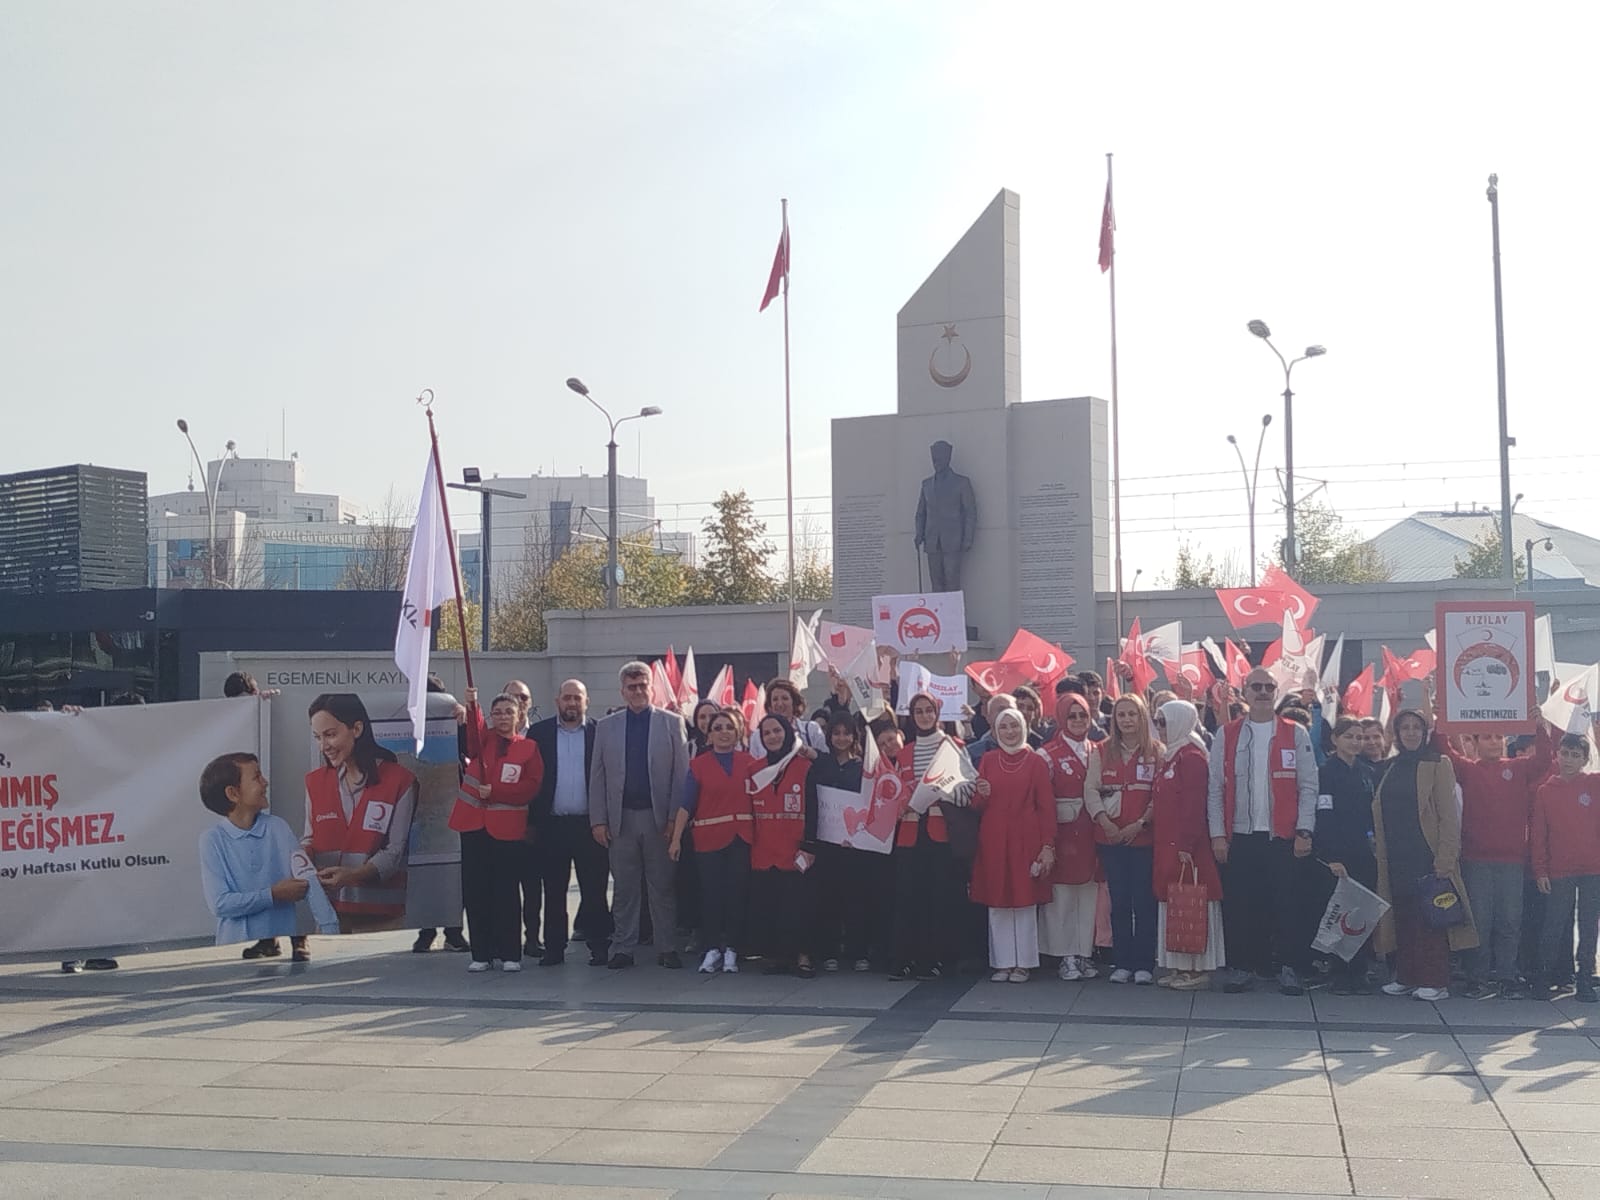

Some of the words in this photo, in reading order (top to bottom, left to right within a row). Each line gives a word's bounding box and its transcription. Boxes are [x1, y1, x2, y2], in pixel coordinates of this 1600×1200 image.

[1465, 615, 1509, 625] KIZILAY
[267, 669, 361, 686] EGEMENLİK
[22, 860, 76, 876] Haftası
[80, 857, 121, 872] Kutlu
[125, 854, 170, 867] Olsun.
